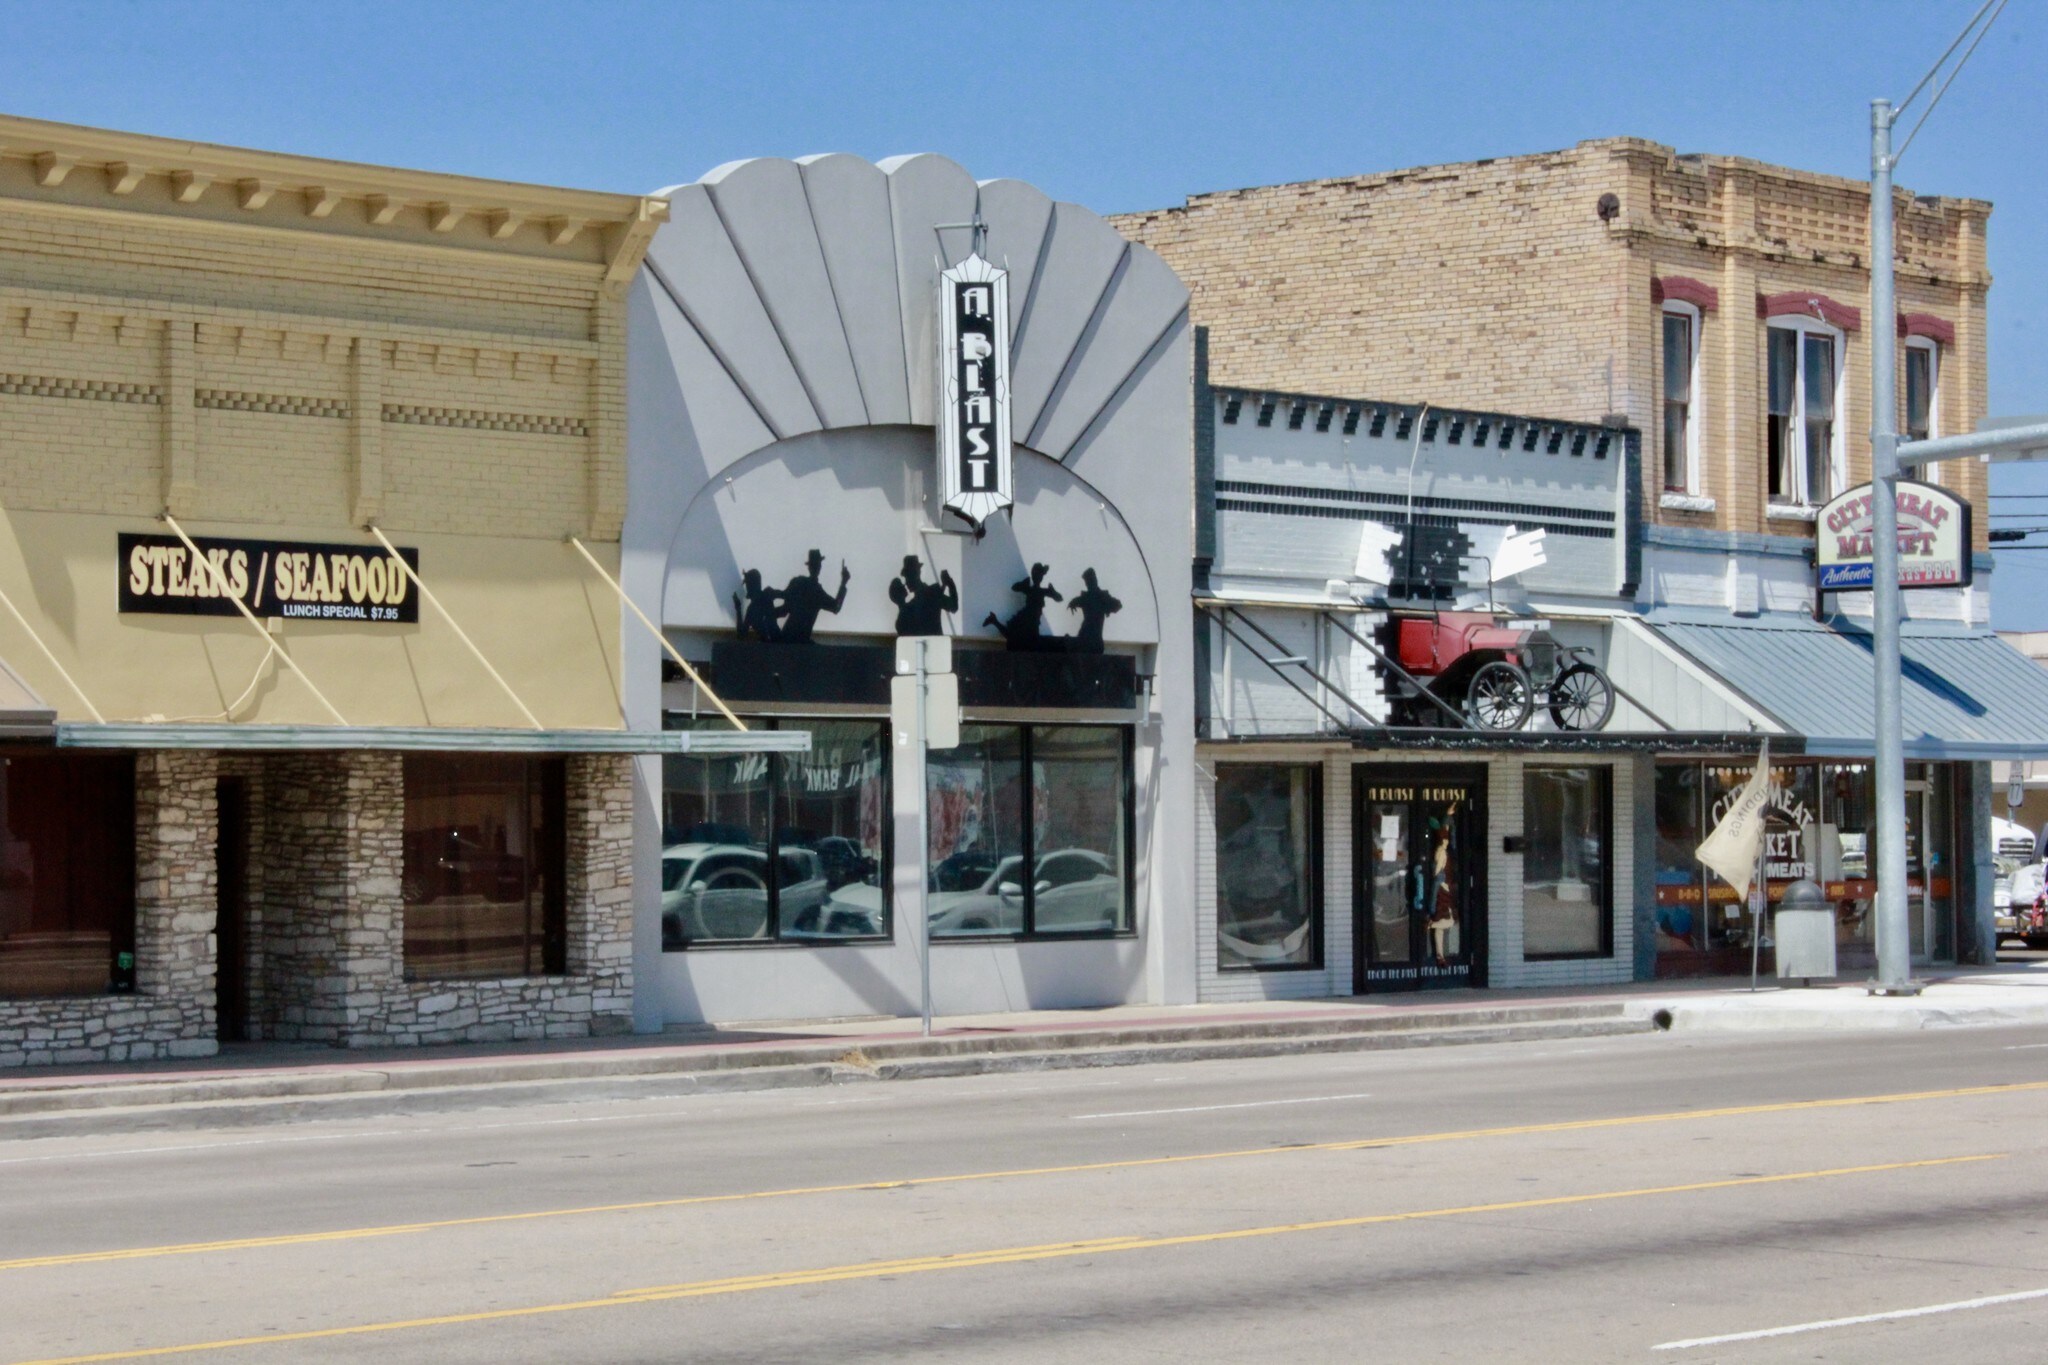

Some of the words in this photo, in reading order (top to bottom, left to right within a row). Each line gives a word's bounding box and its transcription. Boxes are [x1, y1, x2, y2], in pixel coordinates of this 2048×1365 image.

[962, 286, 990, 315] A
[960, 332, 993, 488] BLAST
[129, 545, 249, 599] STEAKS
[274, 551, 407, 605] SEAFOOD
[1822, 566, 1873, 586] Authentic
[1897, 566, 1921, 582] xas
[1924, 561, 1952, 581] BBQ
[283, 604, 321, 617] LUNCH
[322, 605, 367, 619] SPECIAL
[370, 607, 399, 620] $7.95
[1368, 788, 1377, 801] A
[1380, 788, 1414, 801] BLAST
[1422, 788, 1430, 801] A
[1433, 788, 1465, 801] BLAST
[1768, 780, 1814, 832] MEAT
[1765, 829, 1801, 859] KET
[1766, 862, 1815, 879] MEATS
